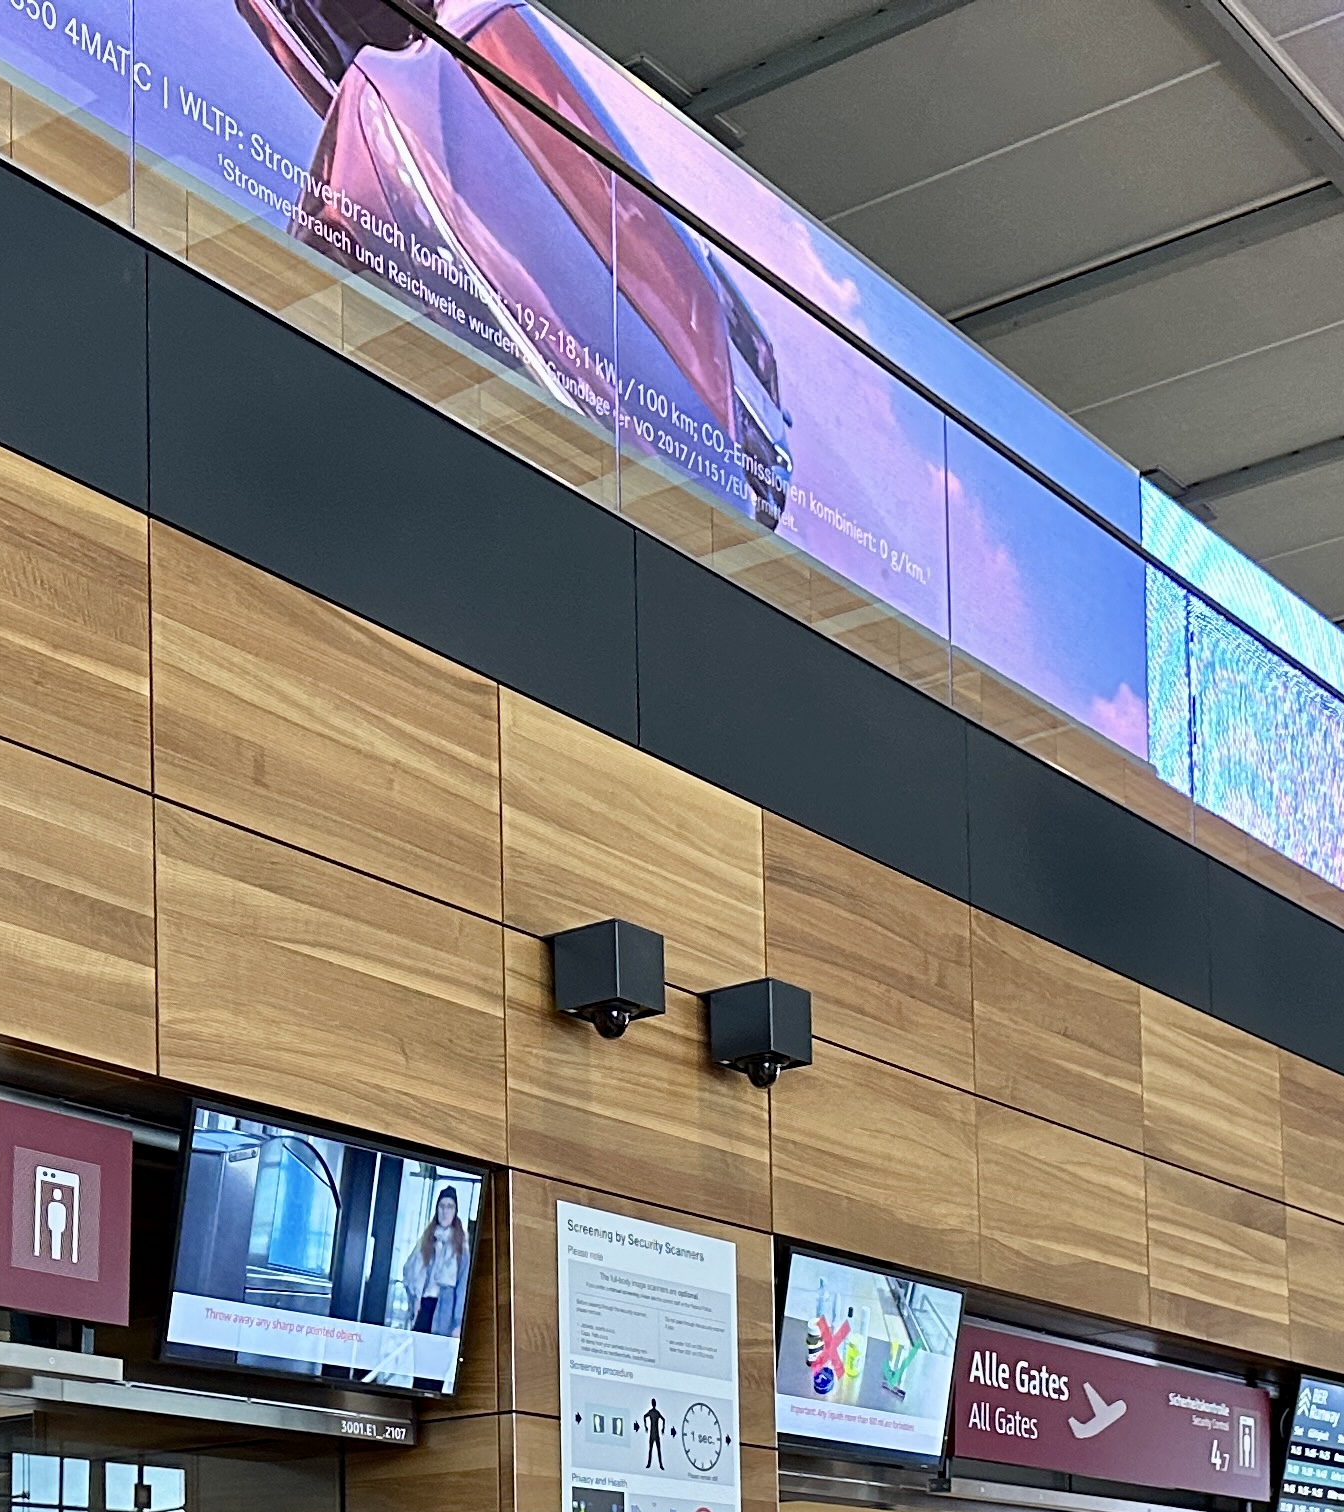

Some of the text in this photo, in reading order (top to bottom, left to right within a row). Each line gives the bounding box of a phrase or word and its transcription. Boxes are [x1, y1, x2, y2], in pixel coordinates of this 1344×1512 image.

[64, 18, 152, 91] 4MATC
[179, 85, 244, 150] WLTP:
[250, 133, 405, 251] Stromverbrauch
[671, 401, 698, 442] km;
[809, 491, 877, 553] kombiniert:
[879, 538, 888, 559] 0
[355, 243, 384, 274] und
[388, 259, 466, 325] Reichweite
[468, 314, 519, 358] wurden
[613, 404, 631, 428] er
[633, 414, 655, 442] VO
[657, 430, 749, 500] 2017/1151/EU
[567, 1218, 705, 1262] Screening by Security Scanners
[205, 1307, 232, 1322] Throw
[232, 1313, 255, 1328] away
[255, 1317, 271, 1331] any
[272, 1318, 294, 1334] sharp
[295, 1325, 305, 1334] or
[305, 1324, 336, 1339] pointed
[968, 1350, 1070, 1401] Alle Gates
[697, 1432, 715, 1446] sec.
[967, 1398, 1039, 1441] All Gates
